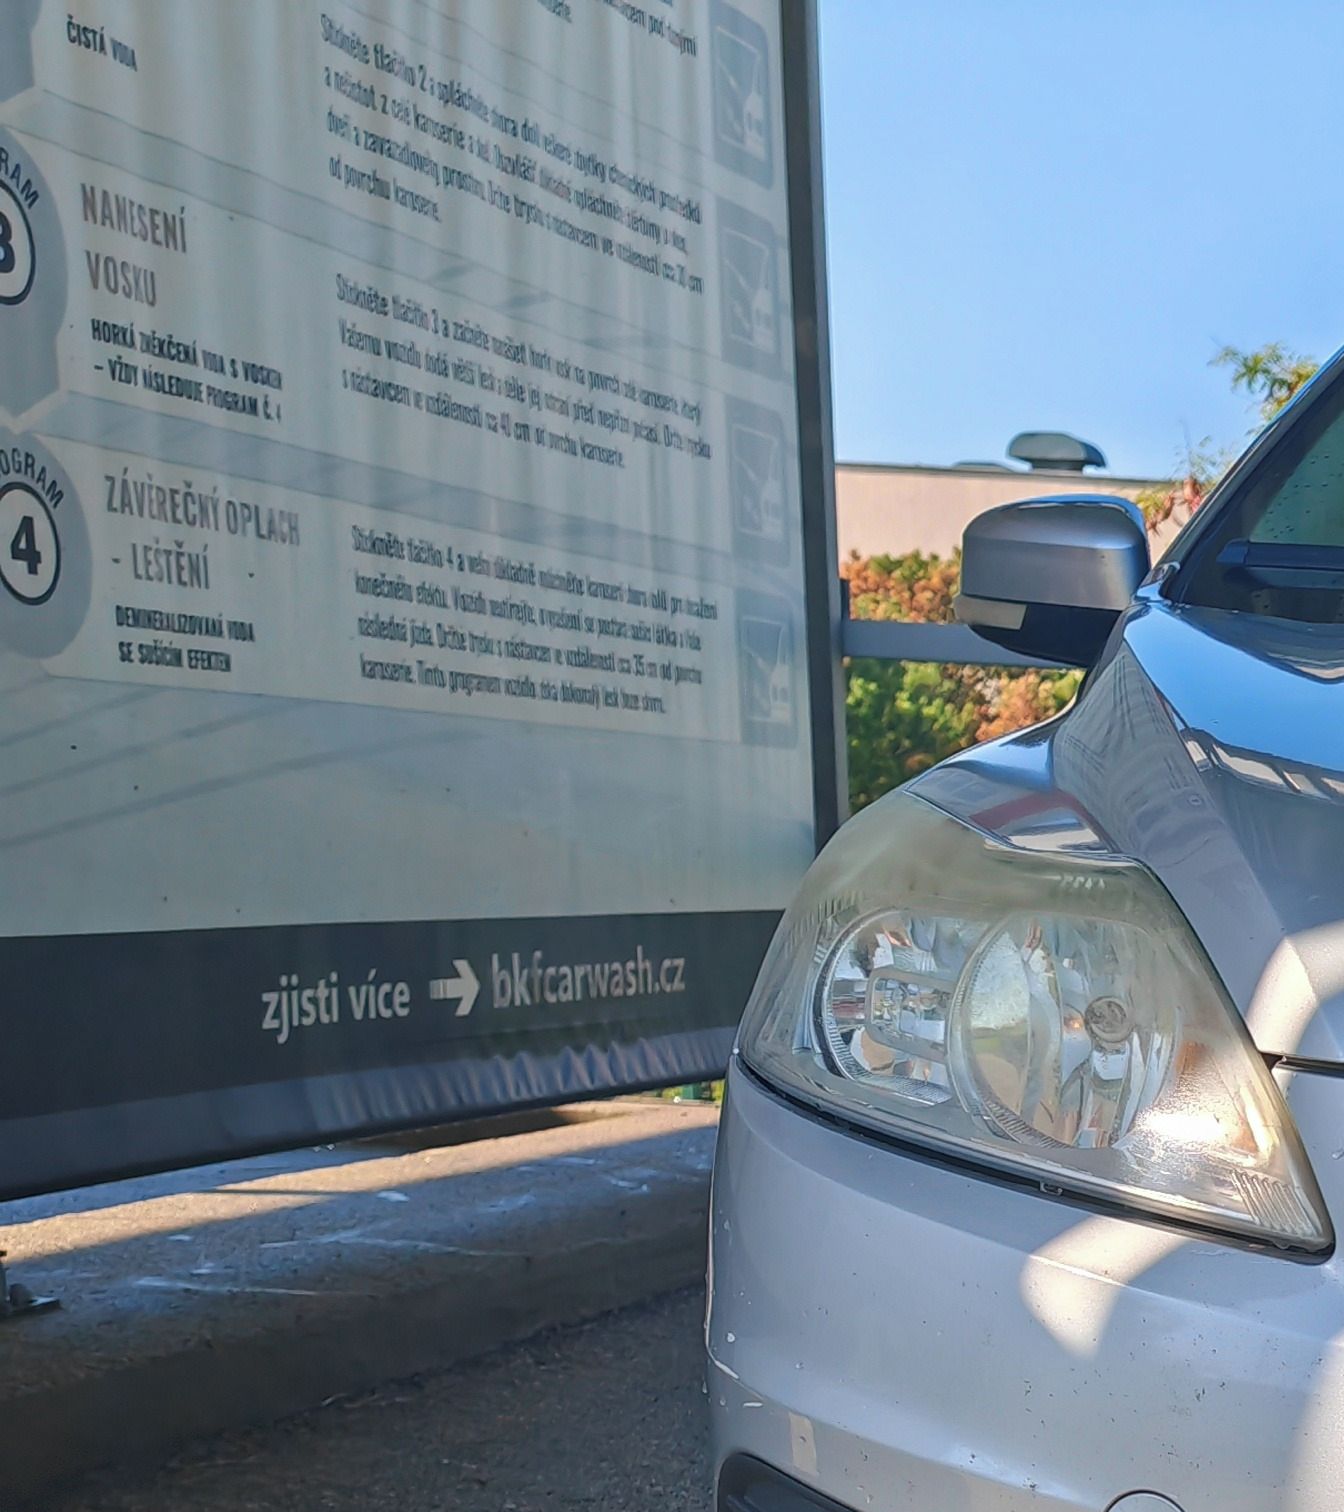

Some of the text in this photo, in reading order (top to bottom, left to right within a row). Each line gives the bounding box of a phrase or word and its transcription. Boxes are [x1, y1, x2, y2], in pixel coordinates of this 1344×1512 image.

[67, 14, 107, 55] ČISTÁ
[85, 250, 156, 306] VOSKU
[91, 318, 137, 350] HORKÁ
[108, 355, 138, 386] VŽDY
[105, 467, 300, 546] ZÁVĚREČNÝ OPLACH
[11, 516, 42, 575] 4
[132, 536, 210, 589] LEŠTĚNÍ
[118, 642, 134, 663] SE
[262, 945, 686, 1044] zjisti více bkfcarwash.cz
